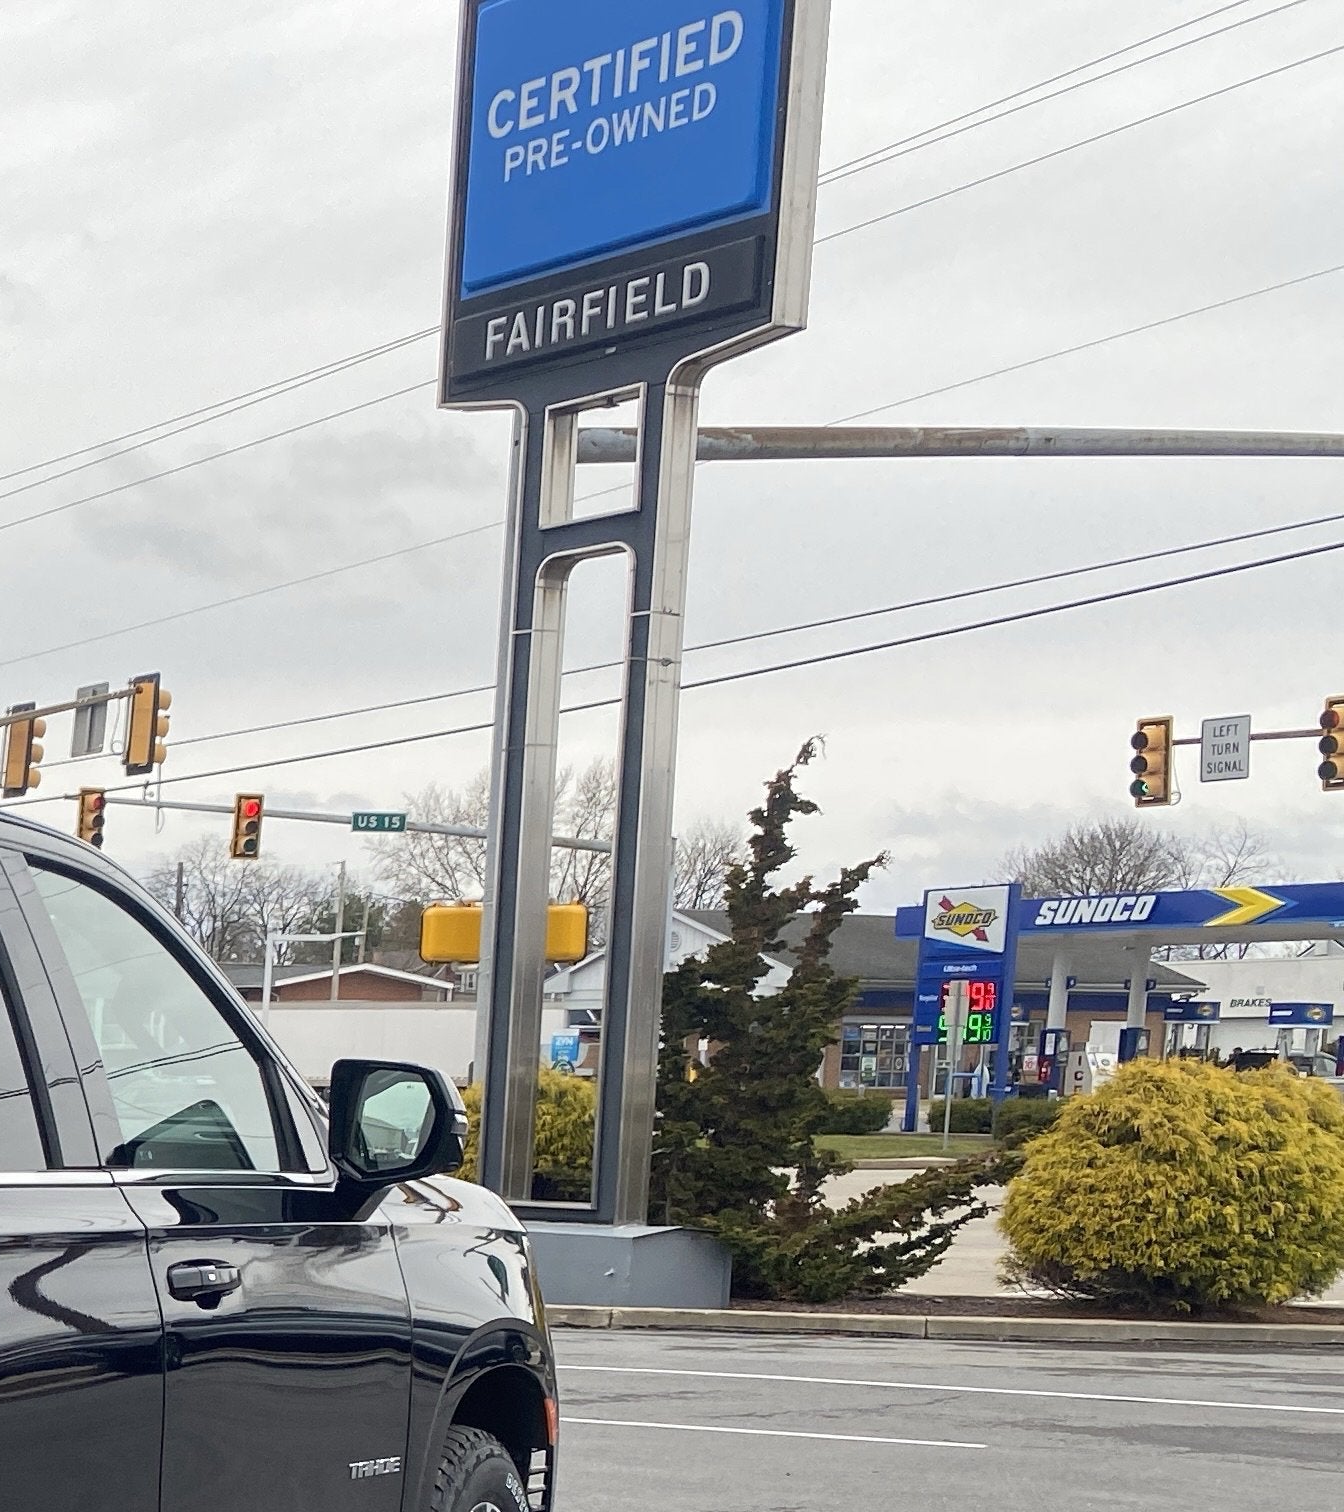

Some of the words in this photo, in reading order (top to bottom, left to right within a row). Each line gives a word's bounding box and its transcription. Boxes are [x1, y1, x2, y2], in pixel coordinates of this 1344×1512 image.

[487, 10, 744, 139] CERTIFIED
[504, 82, 717, 183] PRE-OWNED
[485, 261, 710, 361] FAIRFIELD
[1213, 723, 1238, 738] LEFT
[1211, 742, 1240, 756] TURN
[1206, 761, 1244, 775] SIGNAL
[357, 815, 378, 828] US
[384, 816, 400, 829] 15
[1035, 895, 1156, 926] SUNOCO
[935, 911, 993, 929] SUNOCO
[1229, 997, 1273, 1009] BRAKES
[348, 1456, 402, 1480] TAHOE
